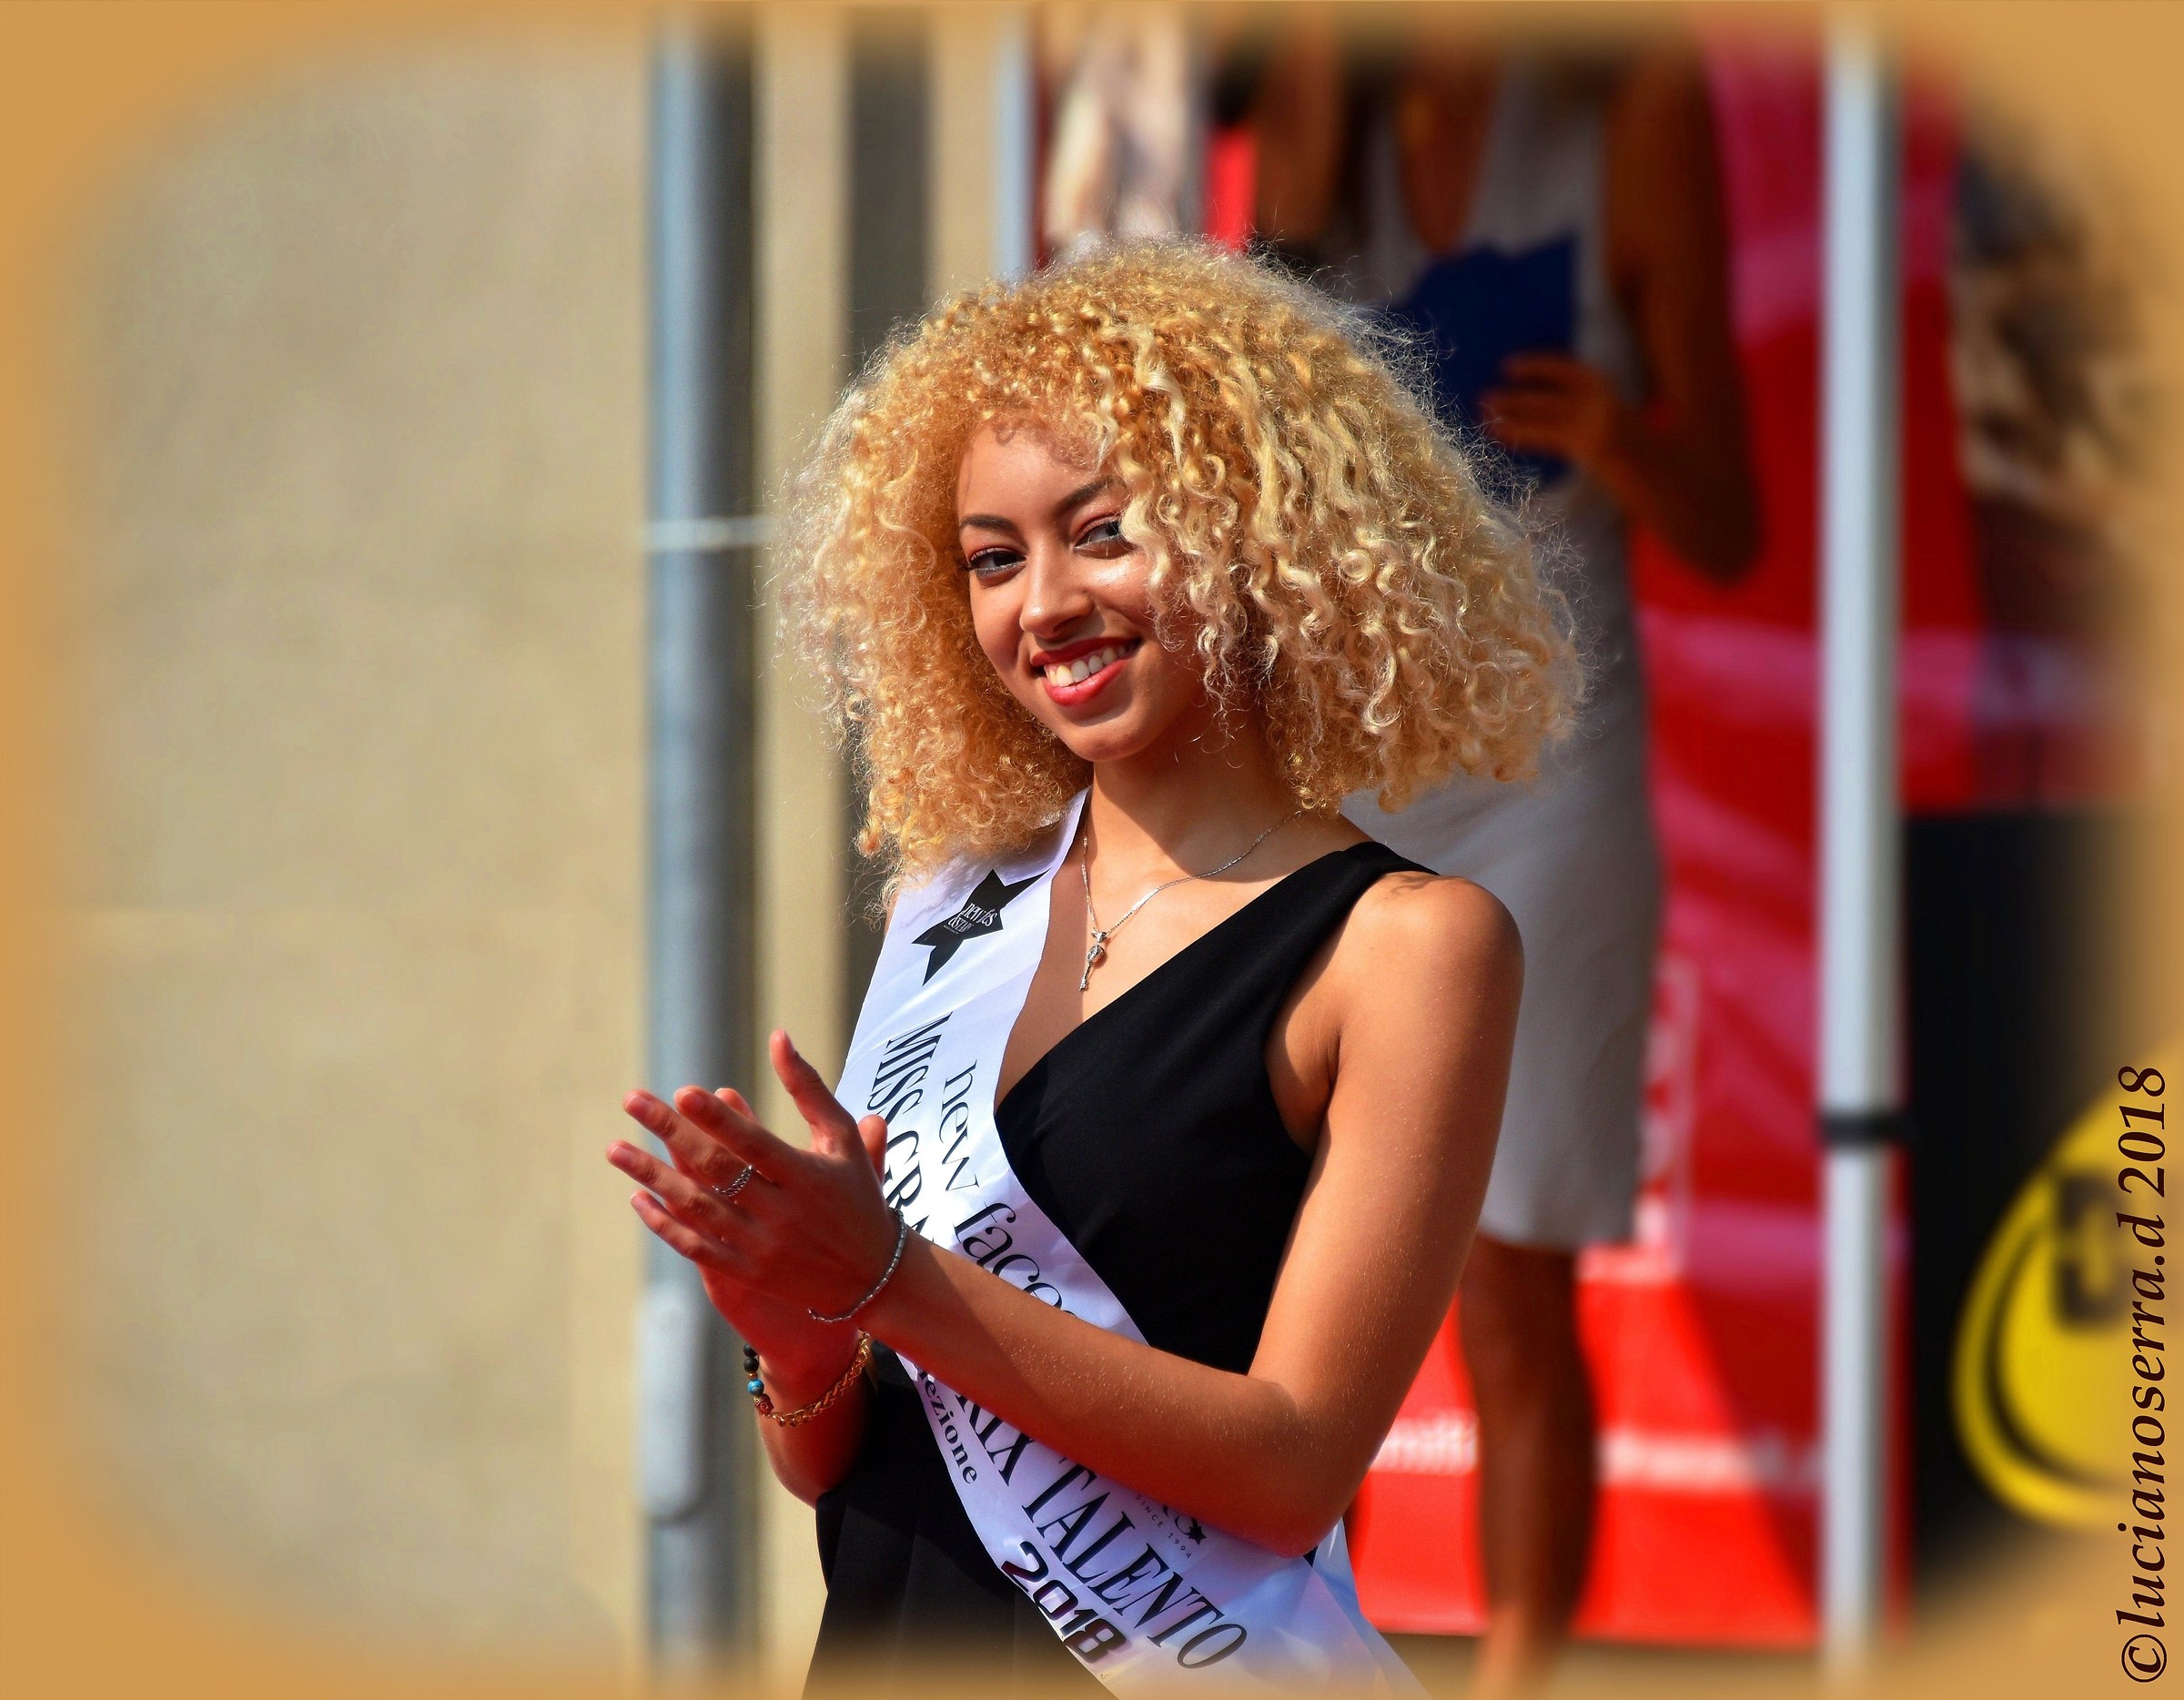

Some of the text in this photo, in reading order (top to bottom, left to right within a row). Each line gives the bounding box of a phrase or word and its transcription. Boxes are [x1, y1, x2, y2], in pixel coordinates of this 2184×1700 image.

[939, 1059, 1077, 1317] new face
[867, 1011, 954, 1127] MISS
[1021, 1457, 1248, 1669] TALENTO
[1001, 1541, 1128, 1664] 2018
[1136, 1494, 1164, 1529] SINCE
[1168, 1533, 1191, 1558] 1994
